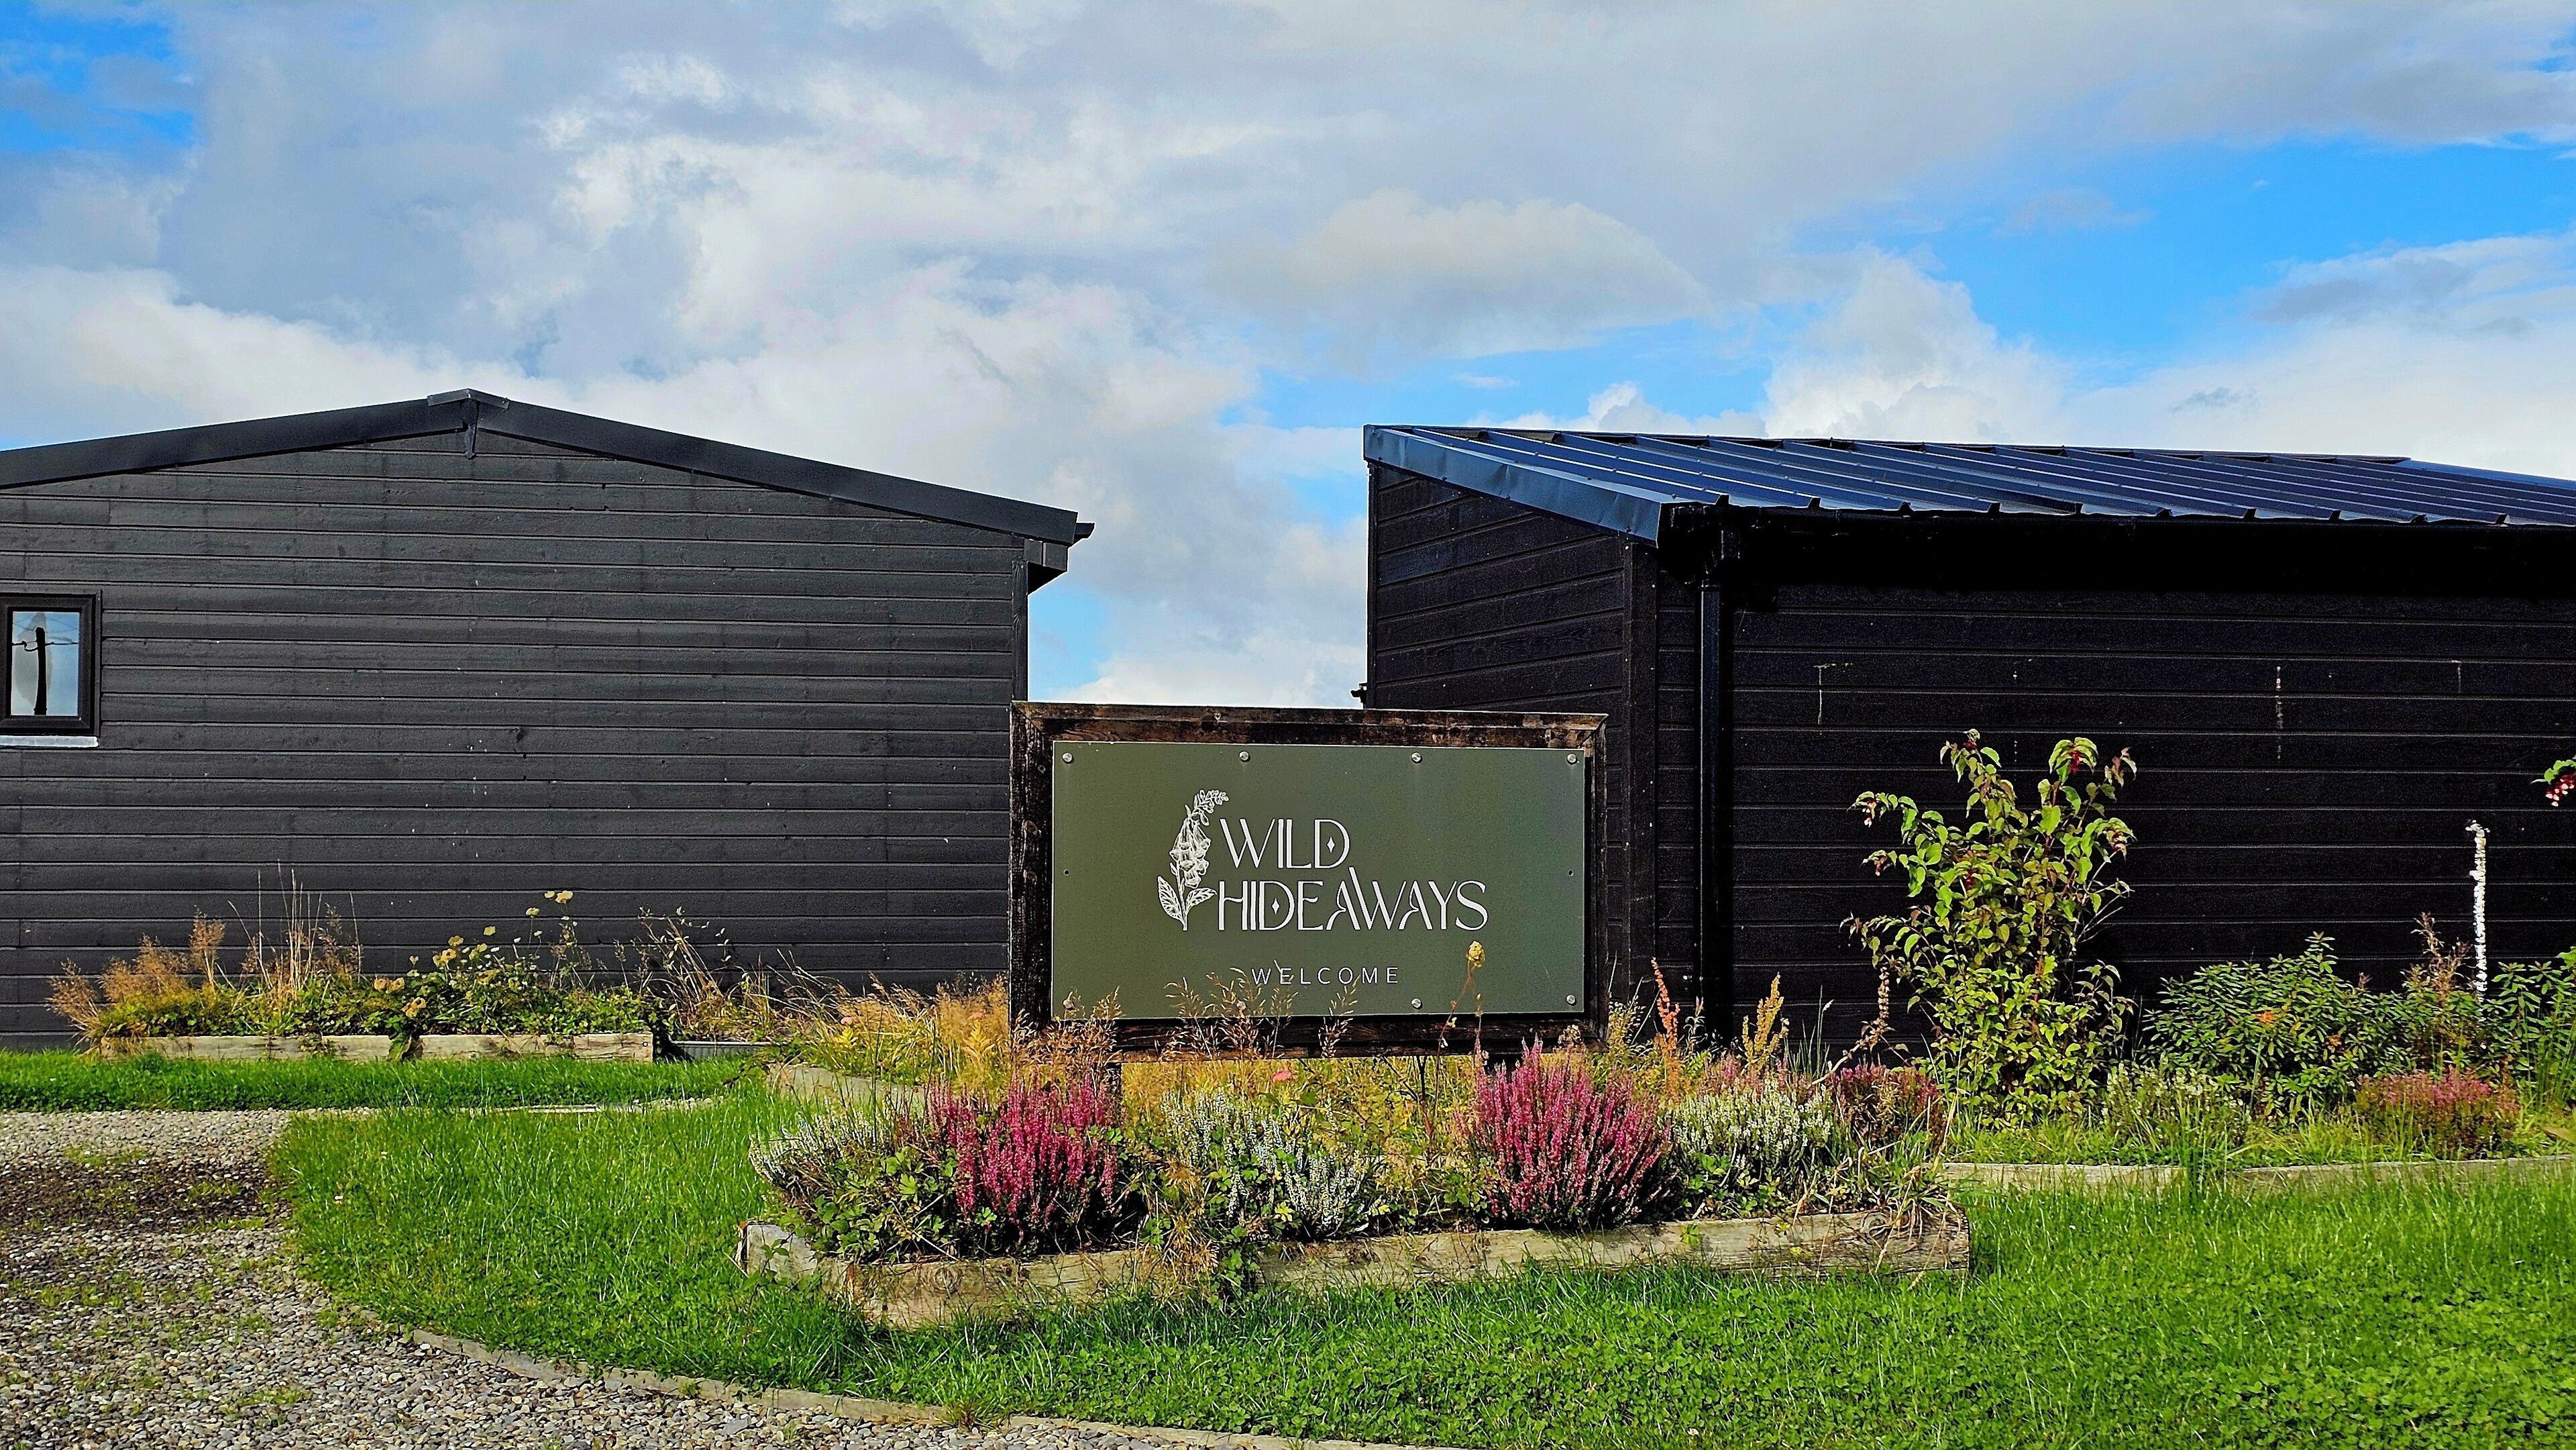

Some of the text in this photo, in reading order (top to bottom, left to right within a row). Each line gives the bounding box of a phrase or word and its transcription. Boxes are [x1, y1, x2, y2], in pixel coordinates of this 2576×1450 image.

[1220, 819, 1350, 868] WILD
[1218, 867, 1488, 931] HIDEAWAYS
[1251, 967, 1398, 984] WELCOME
